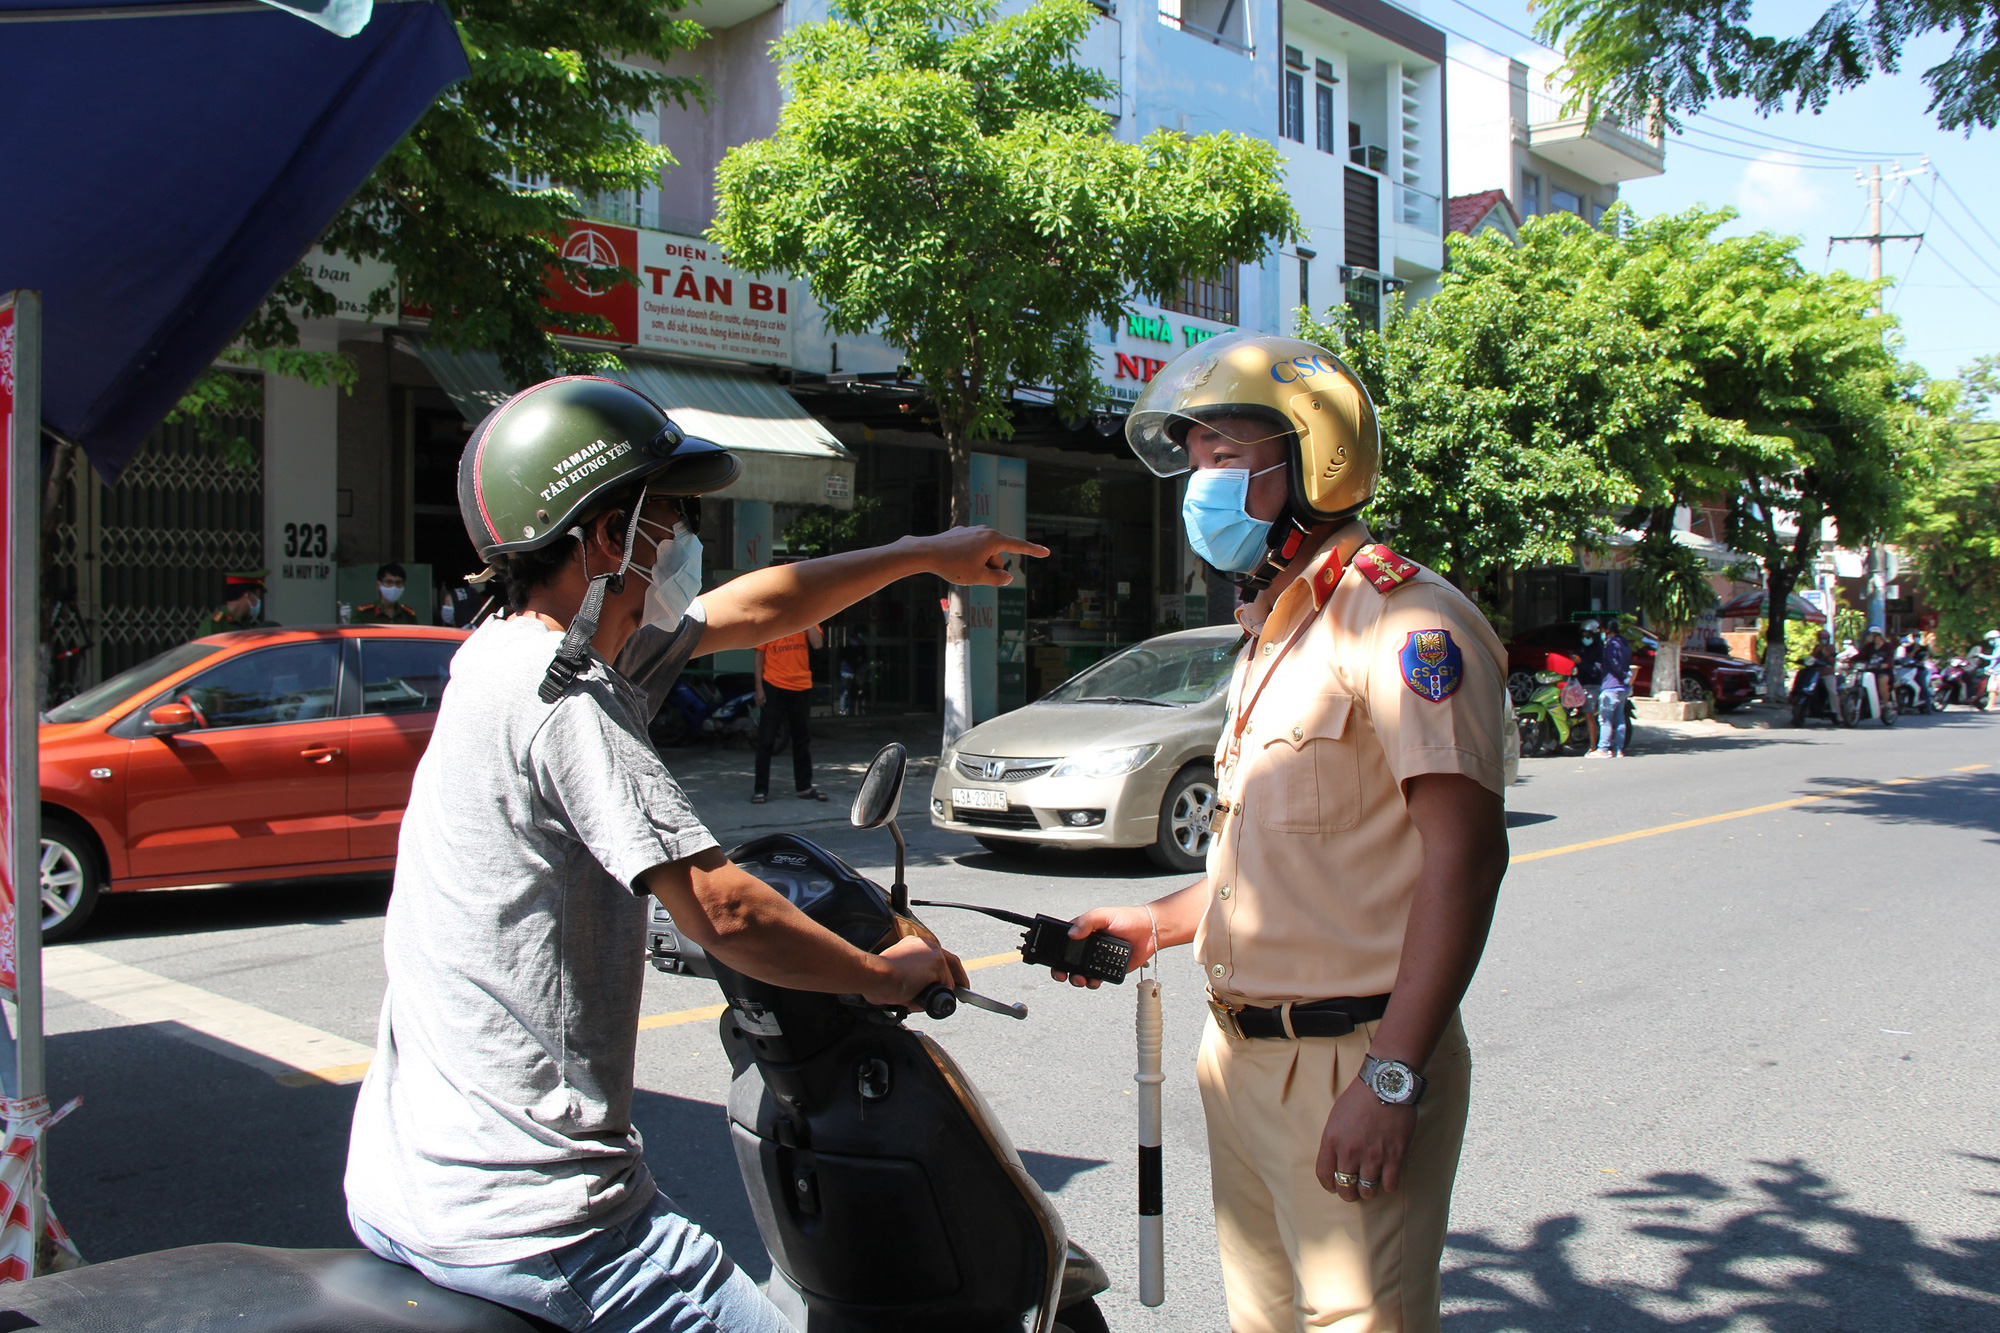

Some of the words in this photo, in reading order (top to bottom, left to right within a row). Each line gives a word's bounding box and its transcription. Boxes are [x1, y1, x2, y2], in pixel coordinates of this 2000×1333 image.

[665, 243, 706, 262] ĐIỆN
[318, 264, 350, 284] bạn
[644, 265, 732, 306] TÂN
[749, 282, 787, 315] BI
[644, 300, 669, 316] Chuyên
[671, 304, 685, 317] kinh
[687, 307, 708, 320] doanh
[709, 310, 723, 324] điện
[743, 315, 759, 330] dụng
[710, 325, 727, 341] hàng
[728, 327, 740, 340] kim
[752, 331, 766, 346] điện
[1127, 313, 1173, 344] NHÀ
[552, 439, 608, 475] YAMAHA
[540, 478, 570, 502] TÂN
[567, 454, 608, 485] HƯNG
[605, 440, 633, 461] YÊN
[284, 522, 328, 558] 323
[282, 561, 294, 579] HÀ
[296, 564, 313, 579] HUY
[773, 642, 807, 653] Emirates
[1412, 666, 1430, 678] CS
